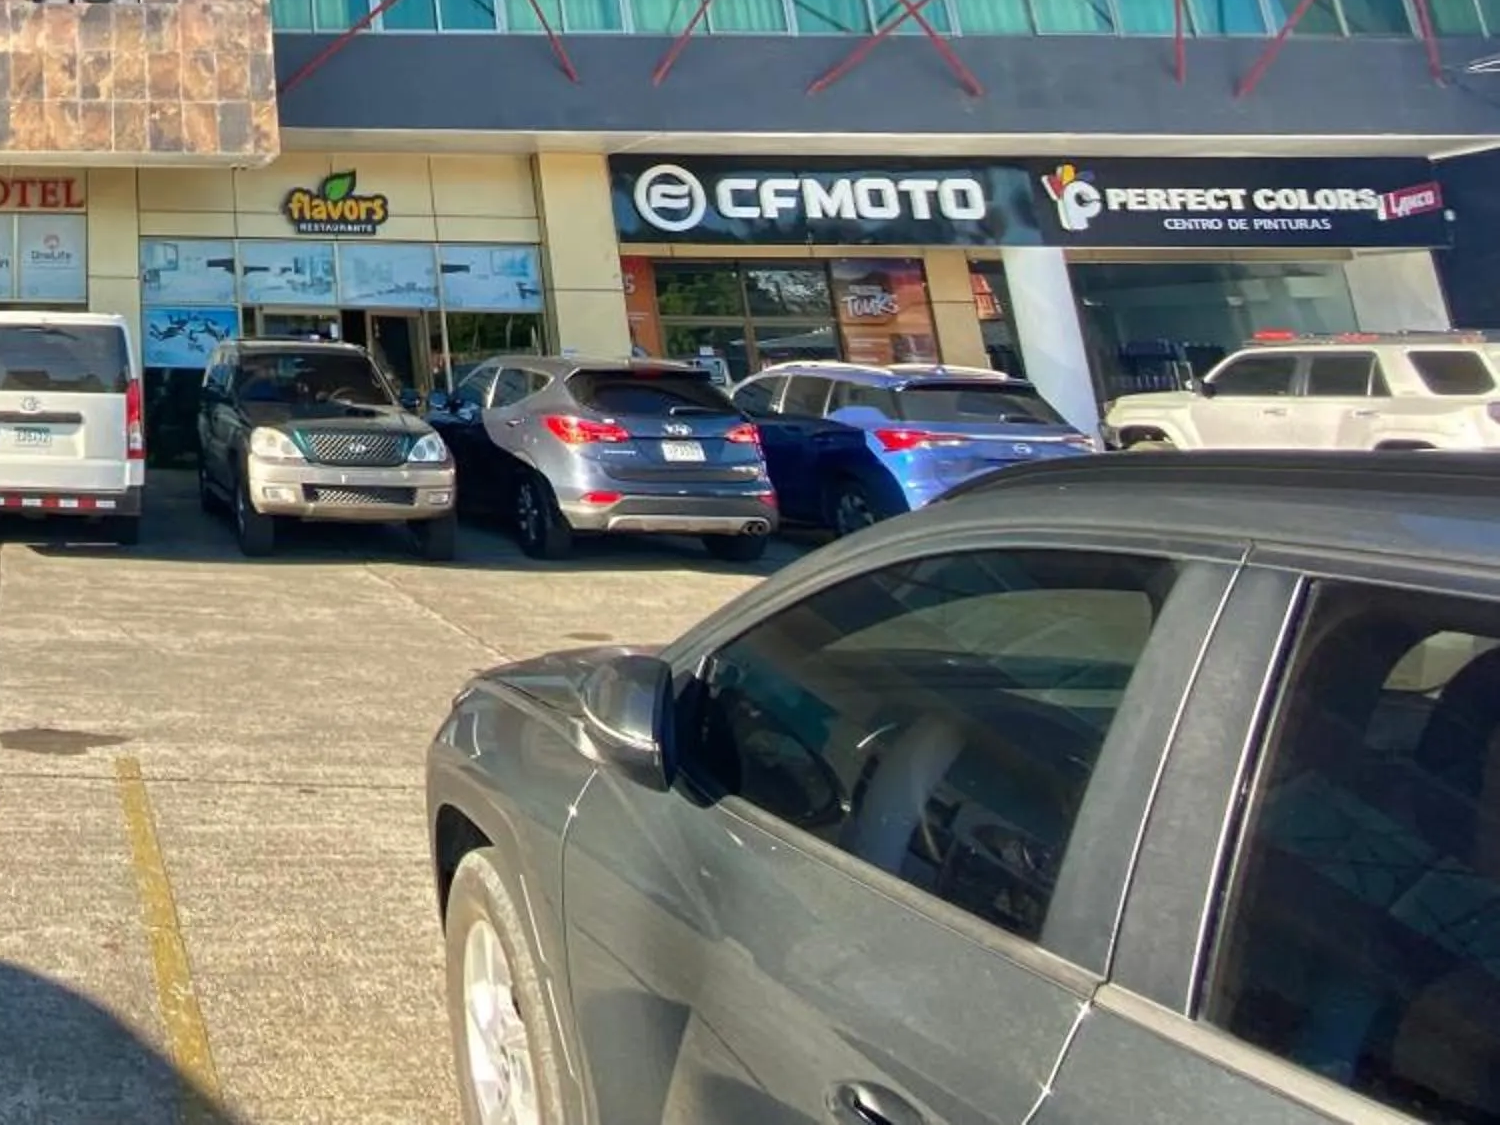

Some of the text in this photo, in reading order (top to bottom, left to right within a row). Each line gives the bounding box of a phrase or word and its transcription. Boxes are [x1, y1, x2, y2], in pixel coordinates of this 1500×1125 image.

[288, 191, 386, 221] flavors
[715, 178, 986, 220] CFMOTO
[1105, 188, 1379, 211] PERFECT COLORS
[1163, 218, 1332, 230] CENTRO DE PINTURAS
